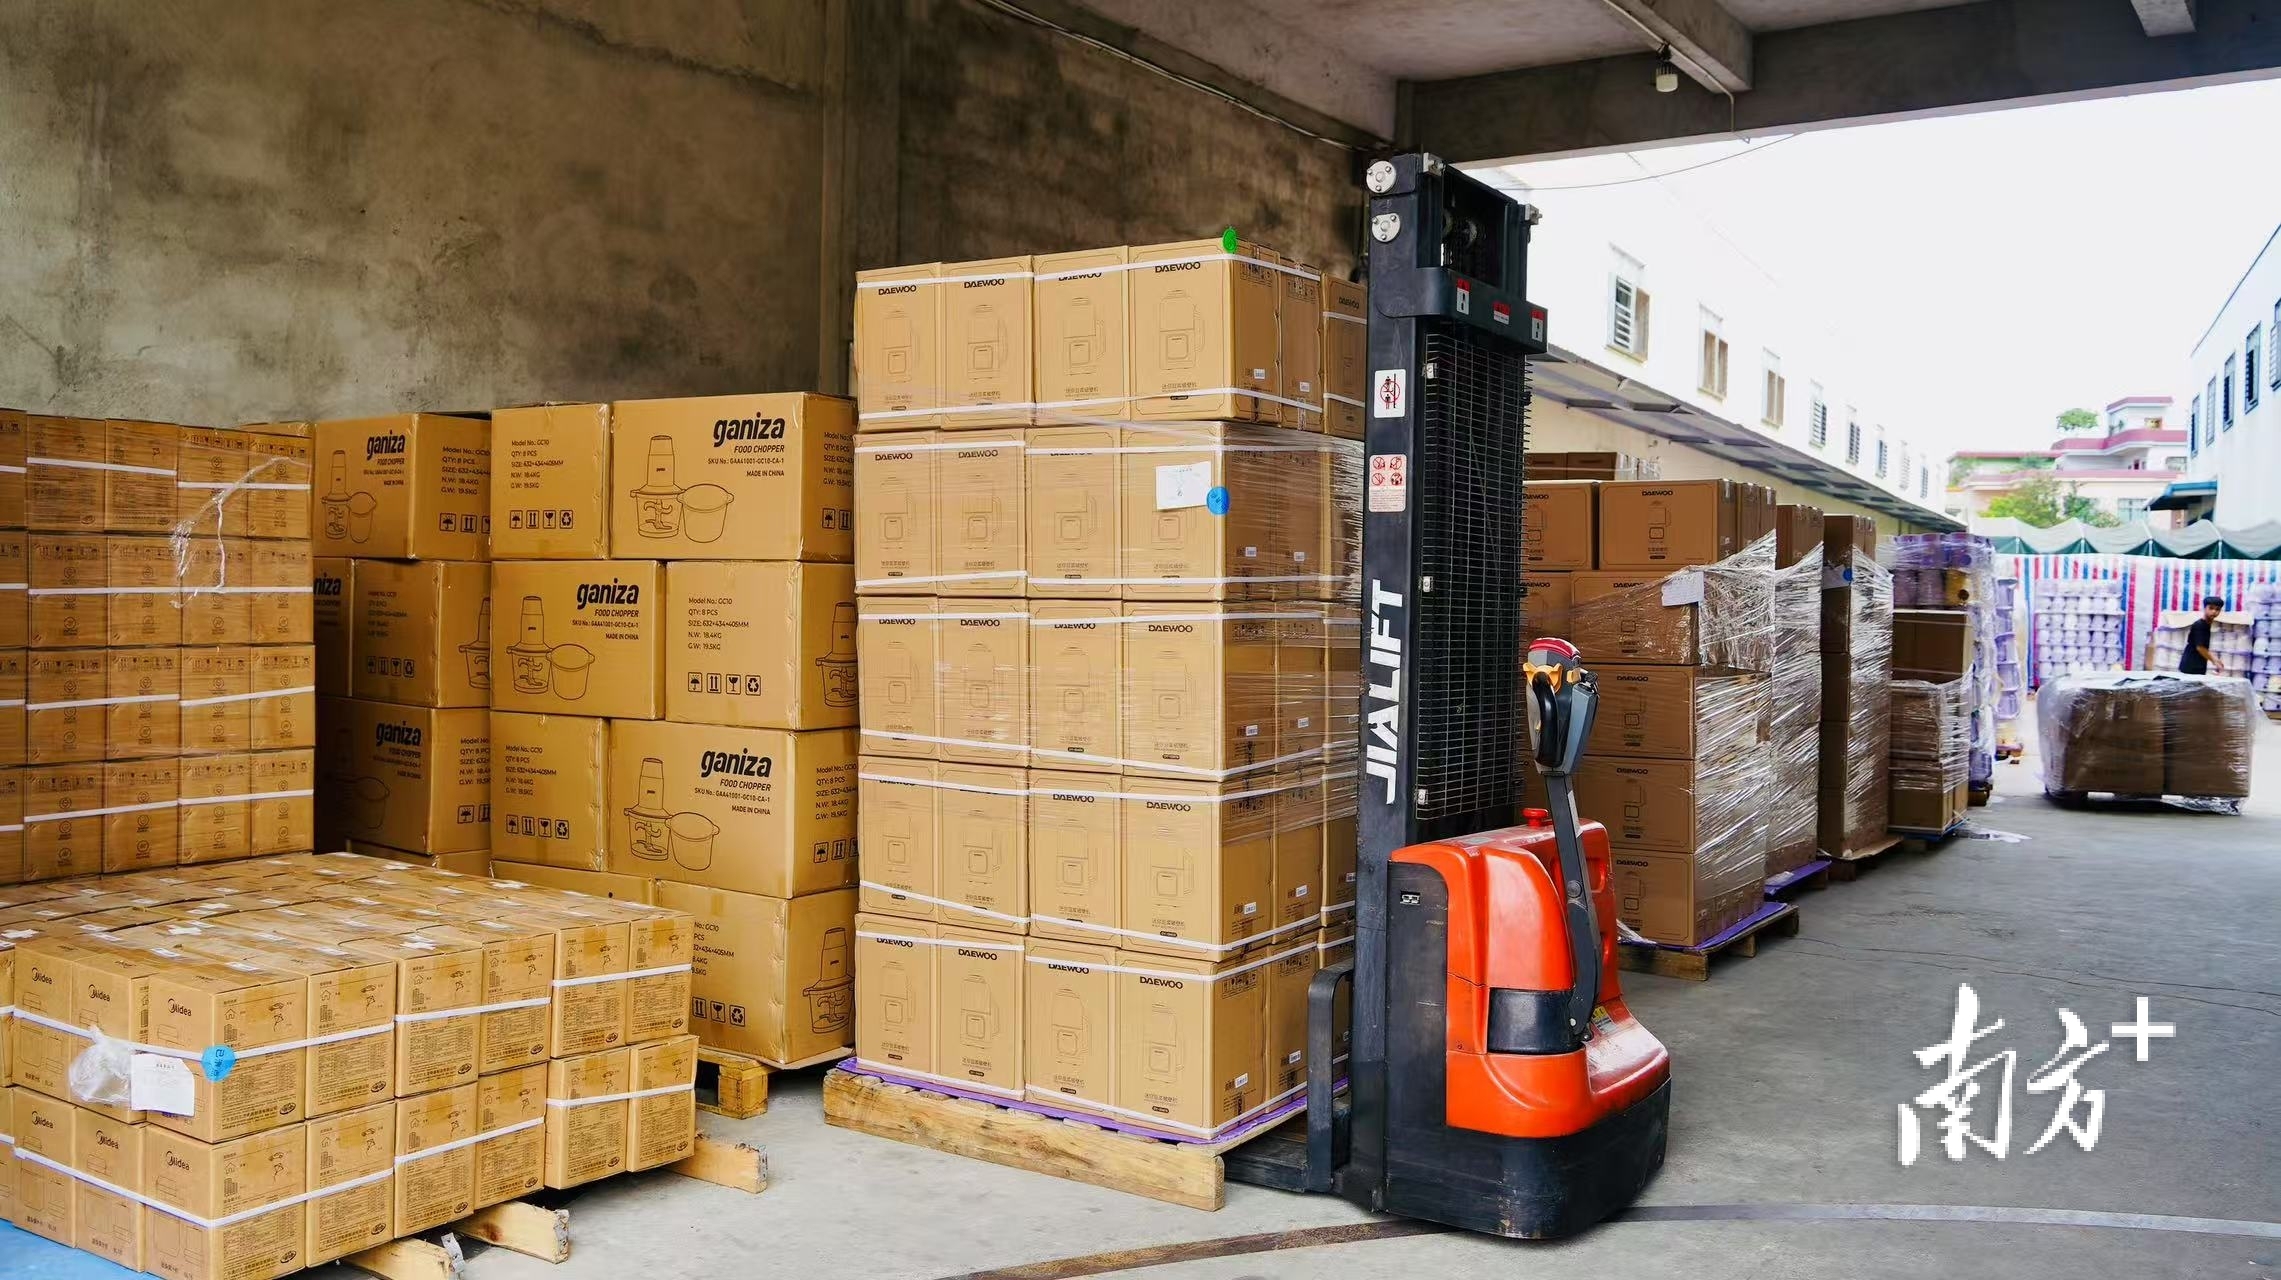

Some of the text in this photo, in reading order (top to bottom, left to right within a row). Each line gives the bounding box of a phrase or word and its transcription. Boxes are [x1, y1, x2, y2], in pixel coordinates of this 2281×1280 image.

[1155, 262, 1201, 273] DAEWOO
[964, 278, 1005, 289] DAEWOO
[878, 285, 917, 296] DAEWOO
[713, 412, 785, 447] ganiza
[367, 430, 405, 460] ganiza
[734, 444, 785, 453] FOOD CHOPPER
[875, 452, 913, 461] DAEWOO
[958, 449, 998, 459] DAEWOO
[577, 578, 639, 610] ganiza
[594, 609, 639, 618] FOOD CHOPPER
[960, 619, 1000, 627] DAEWOO
[1148, 624, 1193, 633] DAEWOO
[605, 632, 618, 640] MADE
[625, 633, 639, 641] CHINA
[1366, 579, 1402, 805] JIALIFT
[376, 720, 421, 747] ganiza
[701, 748, 772, 778] ganiza
[816, 765, 833, 774] Model
[720, 778, 772, 792] FOOD CHOPPER
[834, 776, 846, 784] PCS
[694, 787, 706, 795] SKU
[1052, 793, 1095, 803] DAEWOO
[732, 805, 746, 813] MADE
[754, 807, 770, 816] CHINA
[1146, 801, 1191, 812] DAEWOO
[705, 923, 719, 932] GC10
[694, 933, 705, 941] PCS
[958, 948, 998, 961] DAEWOO
[31, 967, 53, 985] Midea
[1139, 976, 1184, 990] DAEWOO
[88, 984, 111, 1002] Midea
[168, 998, 192, 1017] Midea
[31, 1110, 54, 1129] Midea
[95, 1129, 119, 1150] Midea
[165, 1150, 190, 1171] Midea
